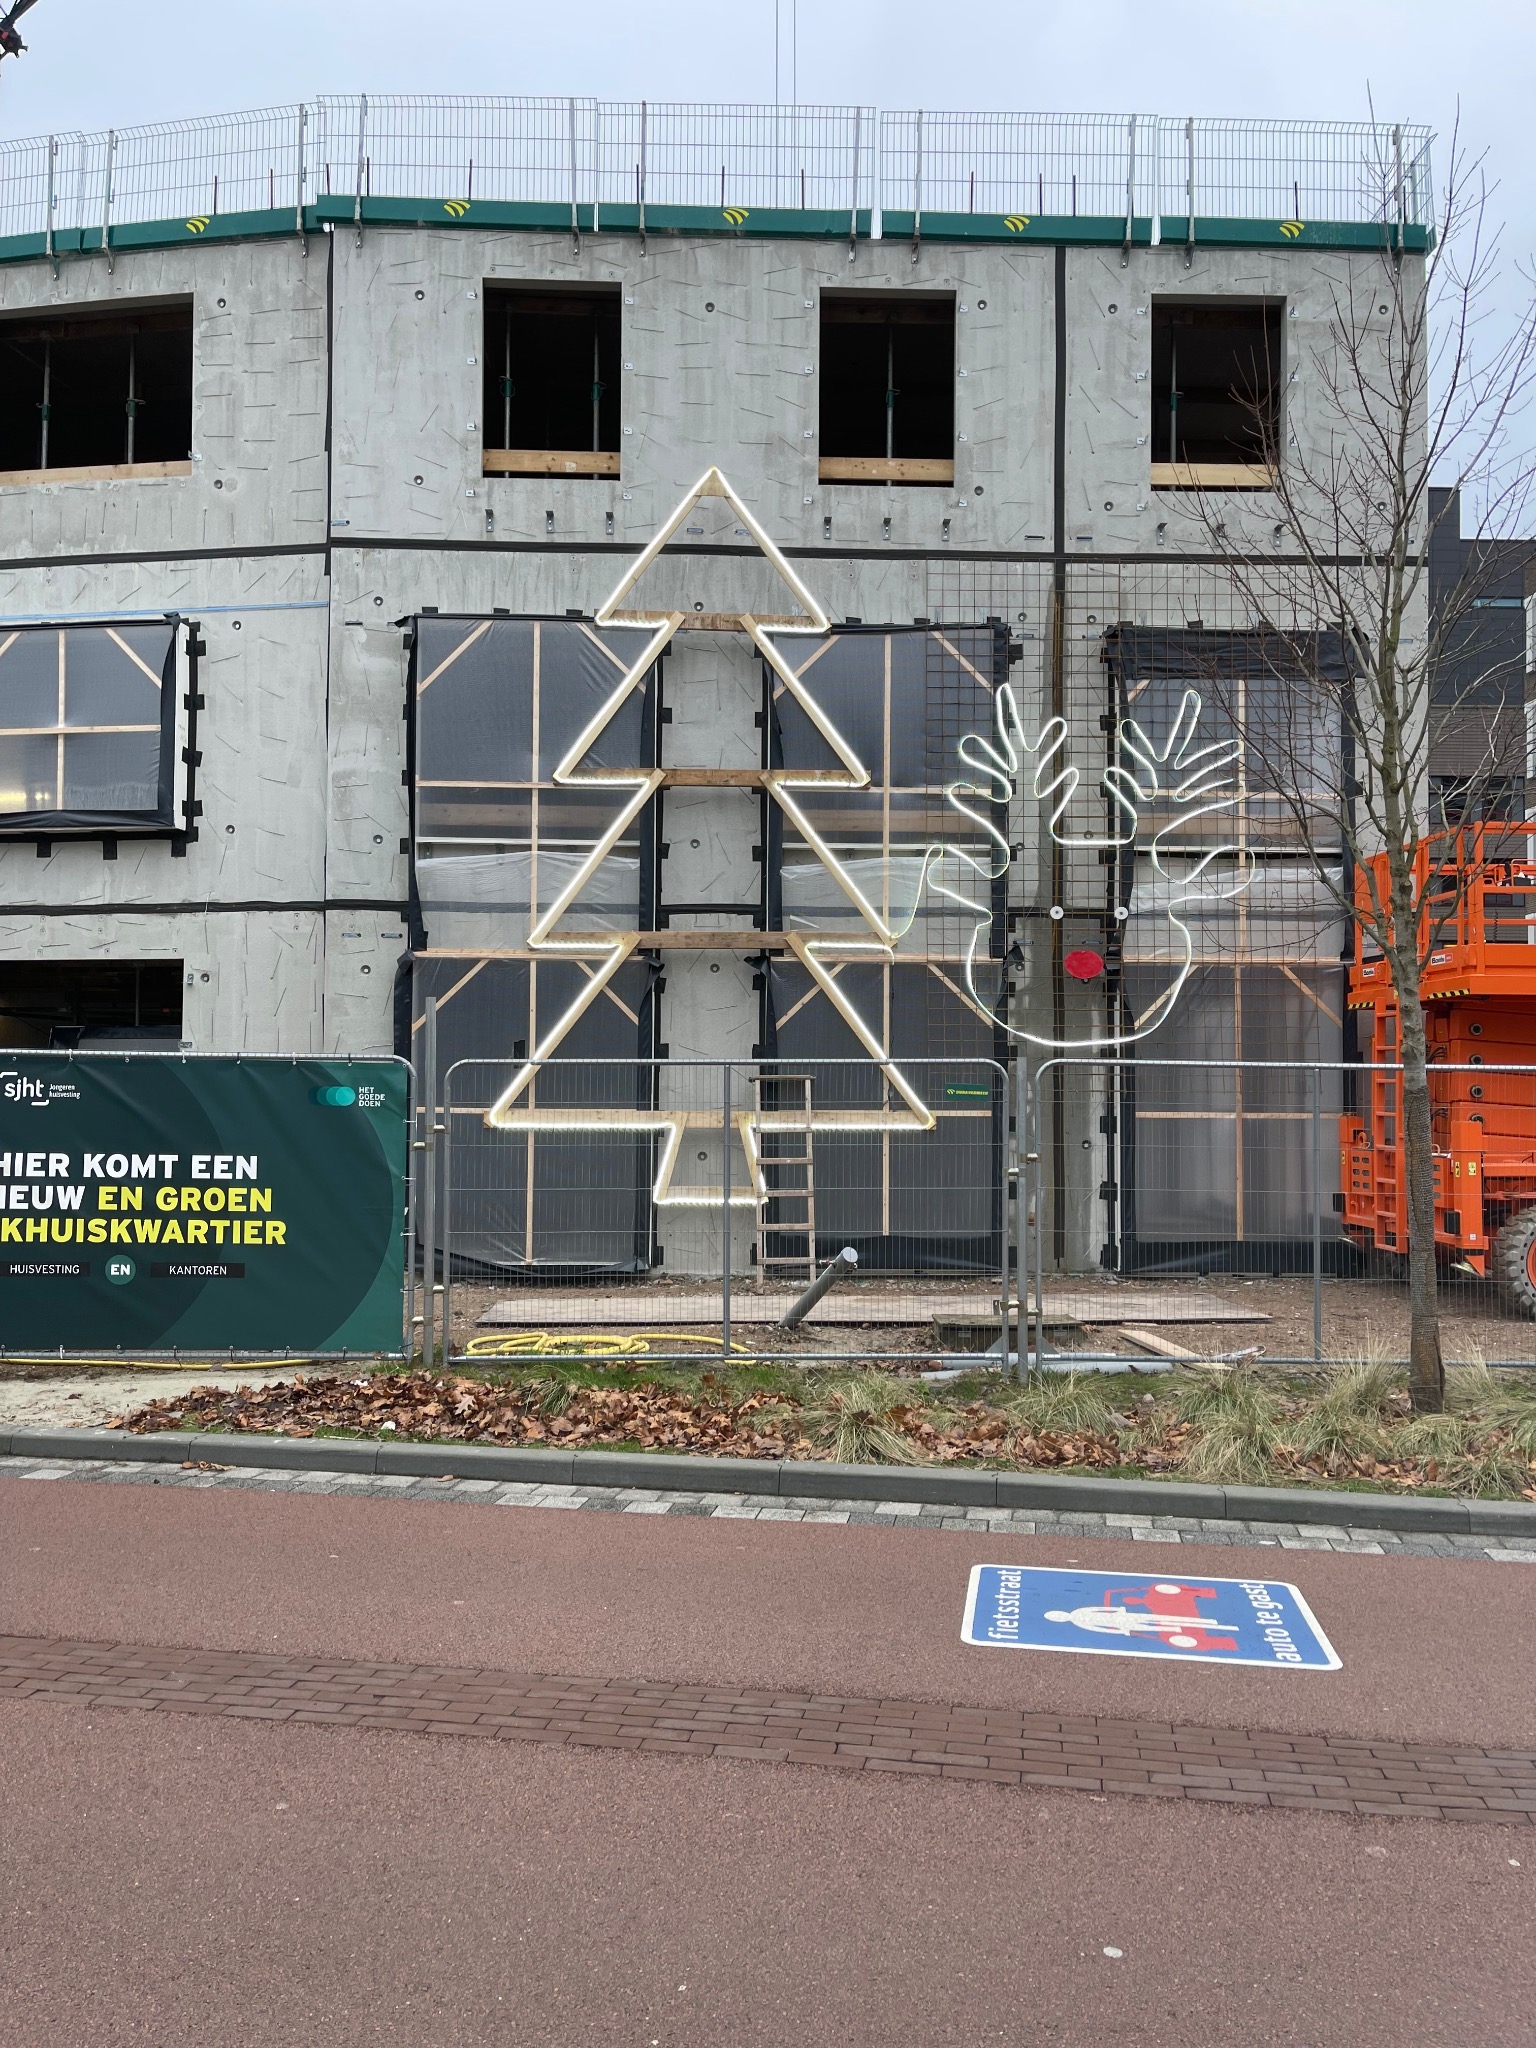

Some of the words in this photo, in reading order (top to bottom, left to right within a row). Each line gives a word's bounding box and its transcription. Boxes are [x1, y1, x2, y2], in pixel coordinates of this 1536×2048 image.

[4, 1076, 45, 1101] sjht
[48, 1091, 81, 1100] huisvesting
[49, 1083, 76, 1092] Jongeren
[358, 1086, 375, 1094] HET
[358, 1093, 386, 1101] GOEDE
[83, 1153, 179, 1179] KOMT
[191, 1155, 258, 1180] EEN
[98, 1186, 143, 1211] EN
[155, 1186, 272, 1212] GROEN
[1, 1217, 287, 1245] KHUISKWARTIER
[9, 1264, 80, 1275] HUISVESTING
[110, 1264, 131, 1276] EN
[169, 1265, 228, 1276] KANTOREN
[988, 1569, 1022, 1640] fietsstraat
[1238, 1583, 1284, 1610] gast
[1255, 1611, 1284, 1625] te
[1263, 1627, 1303, 1662] auto
